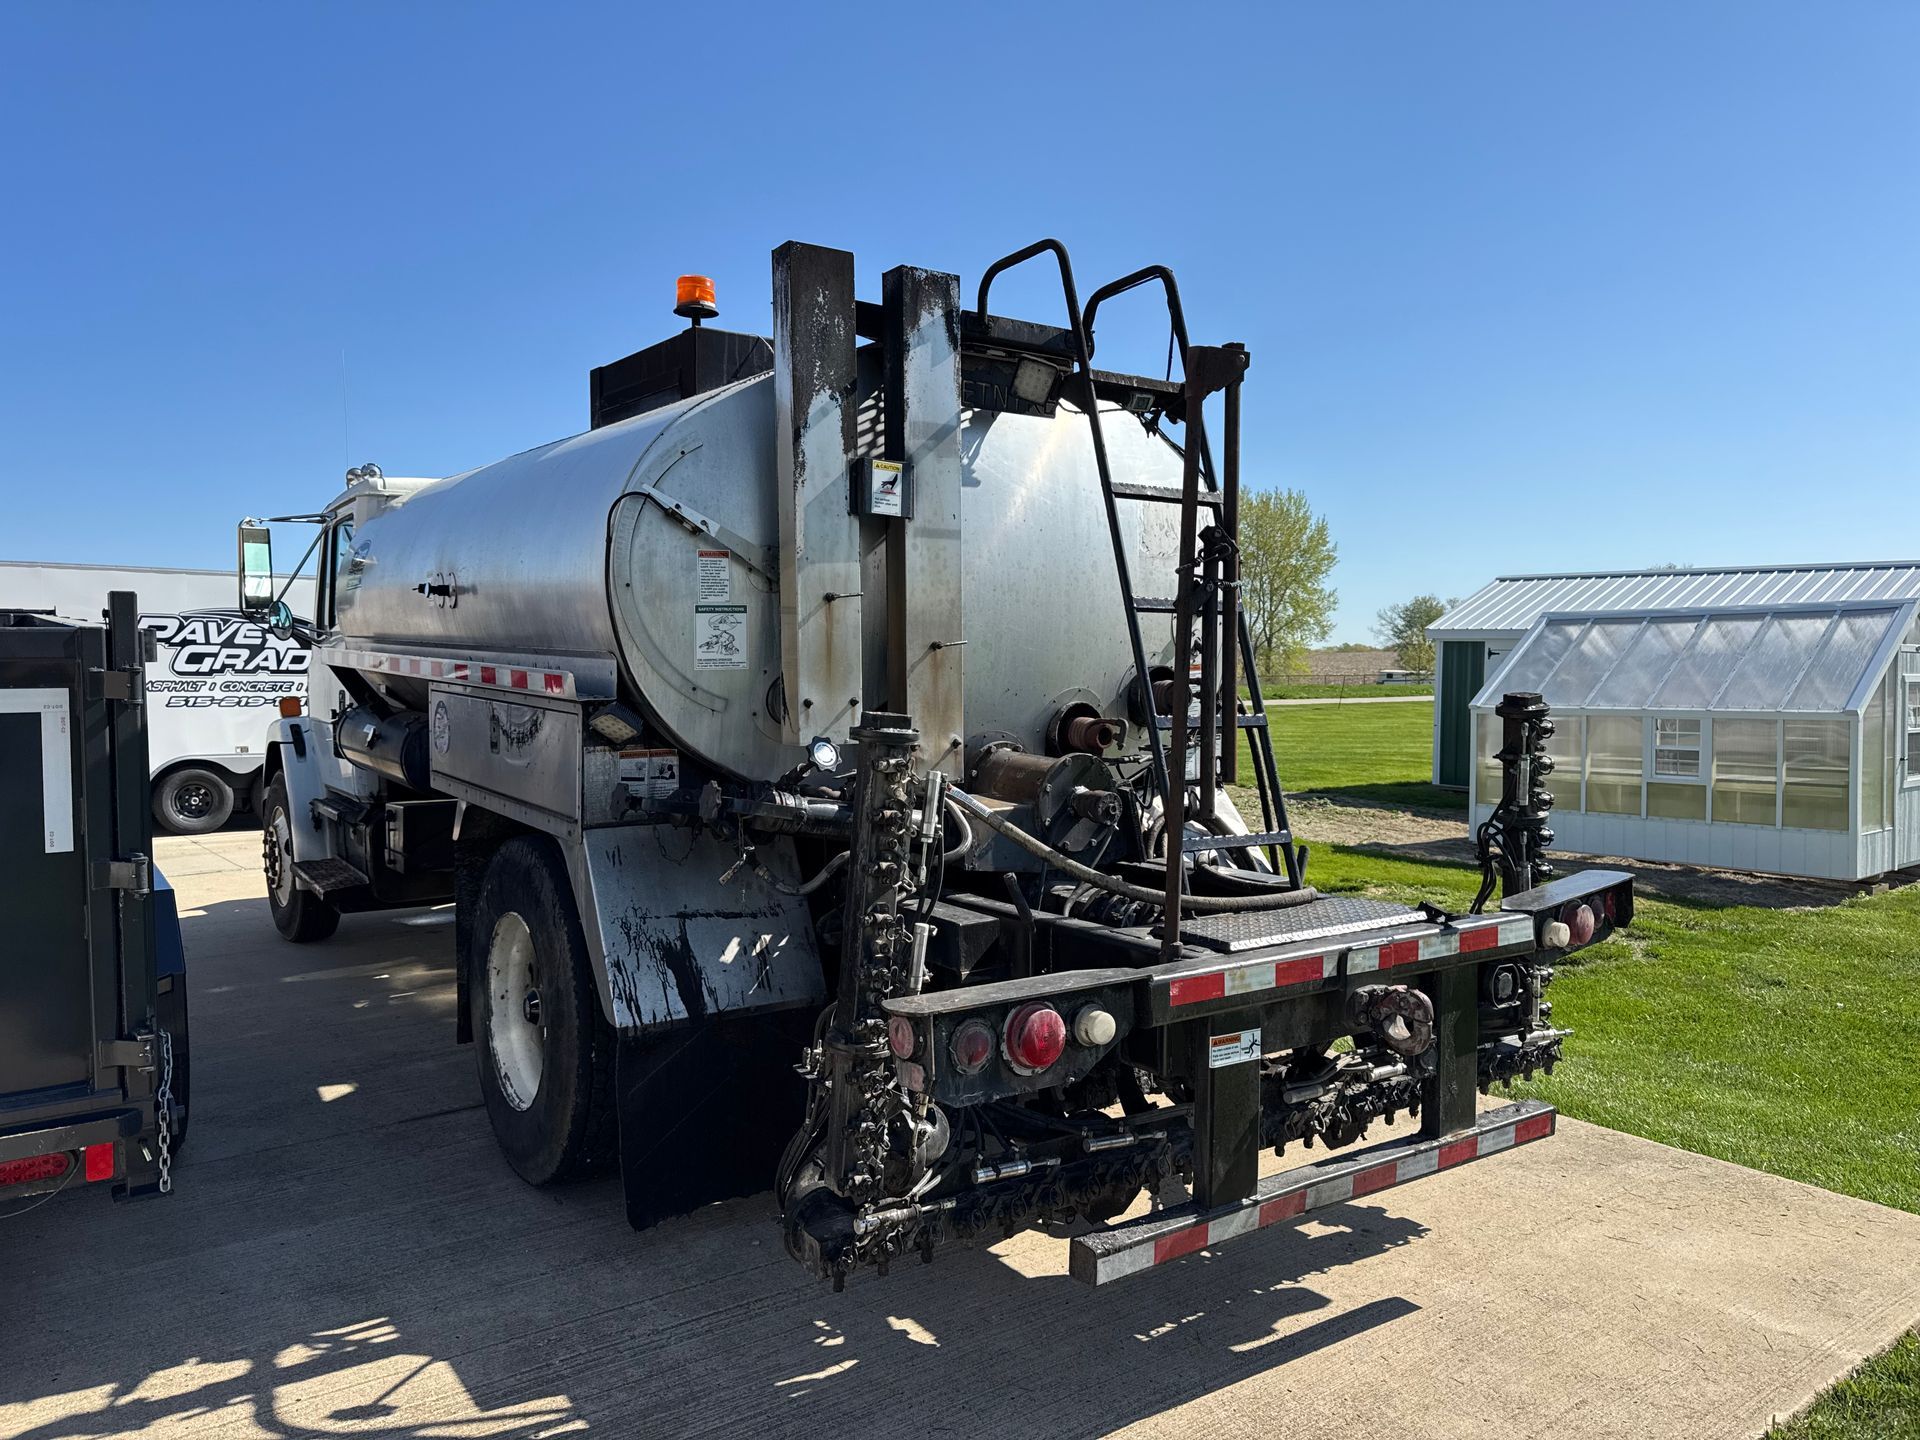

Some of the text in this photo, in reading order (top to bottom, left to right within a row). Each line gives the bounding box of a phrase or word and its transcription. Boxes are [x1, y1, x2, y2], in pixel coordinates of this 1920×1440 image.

[146, 681, 206, 692] ASPHALT
[220, 681, 295, 692] CONCRETE
[1218, 1034, 1241, 1044] WARNING
